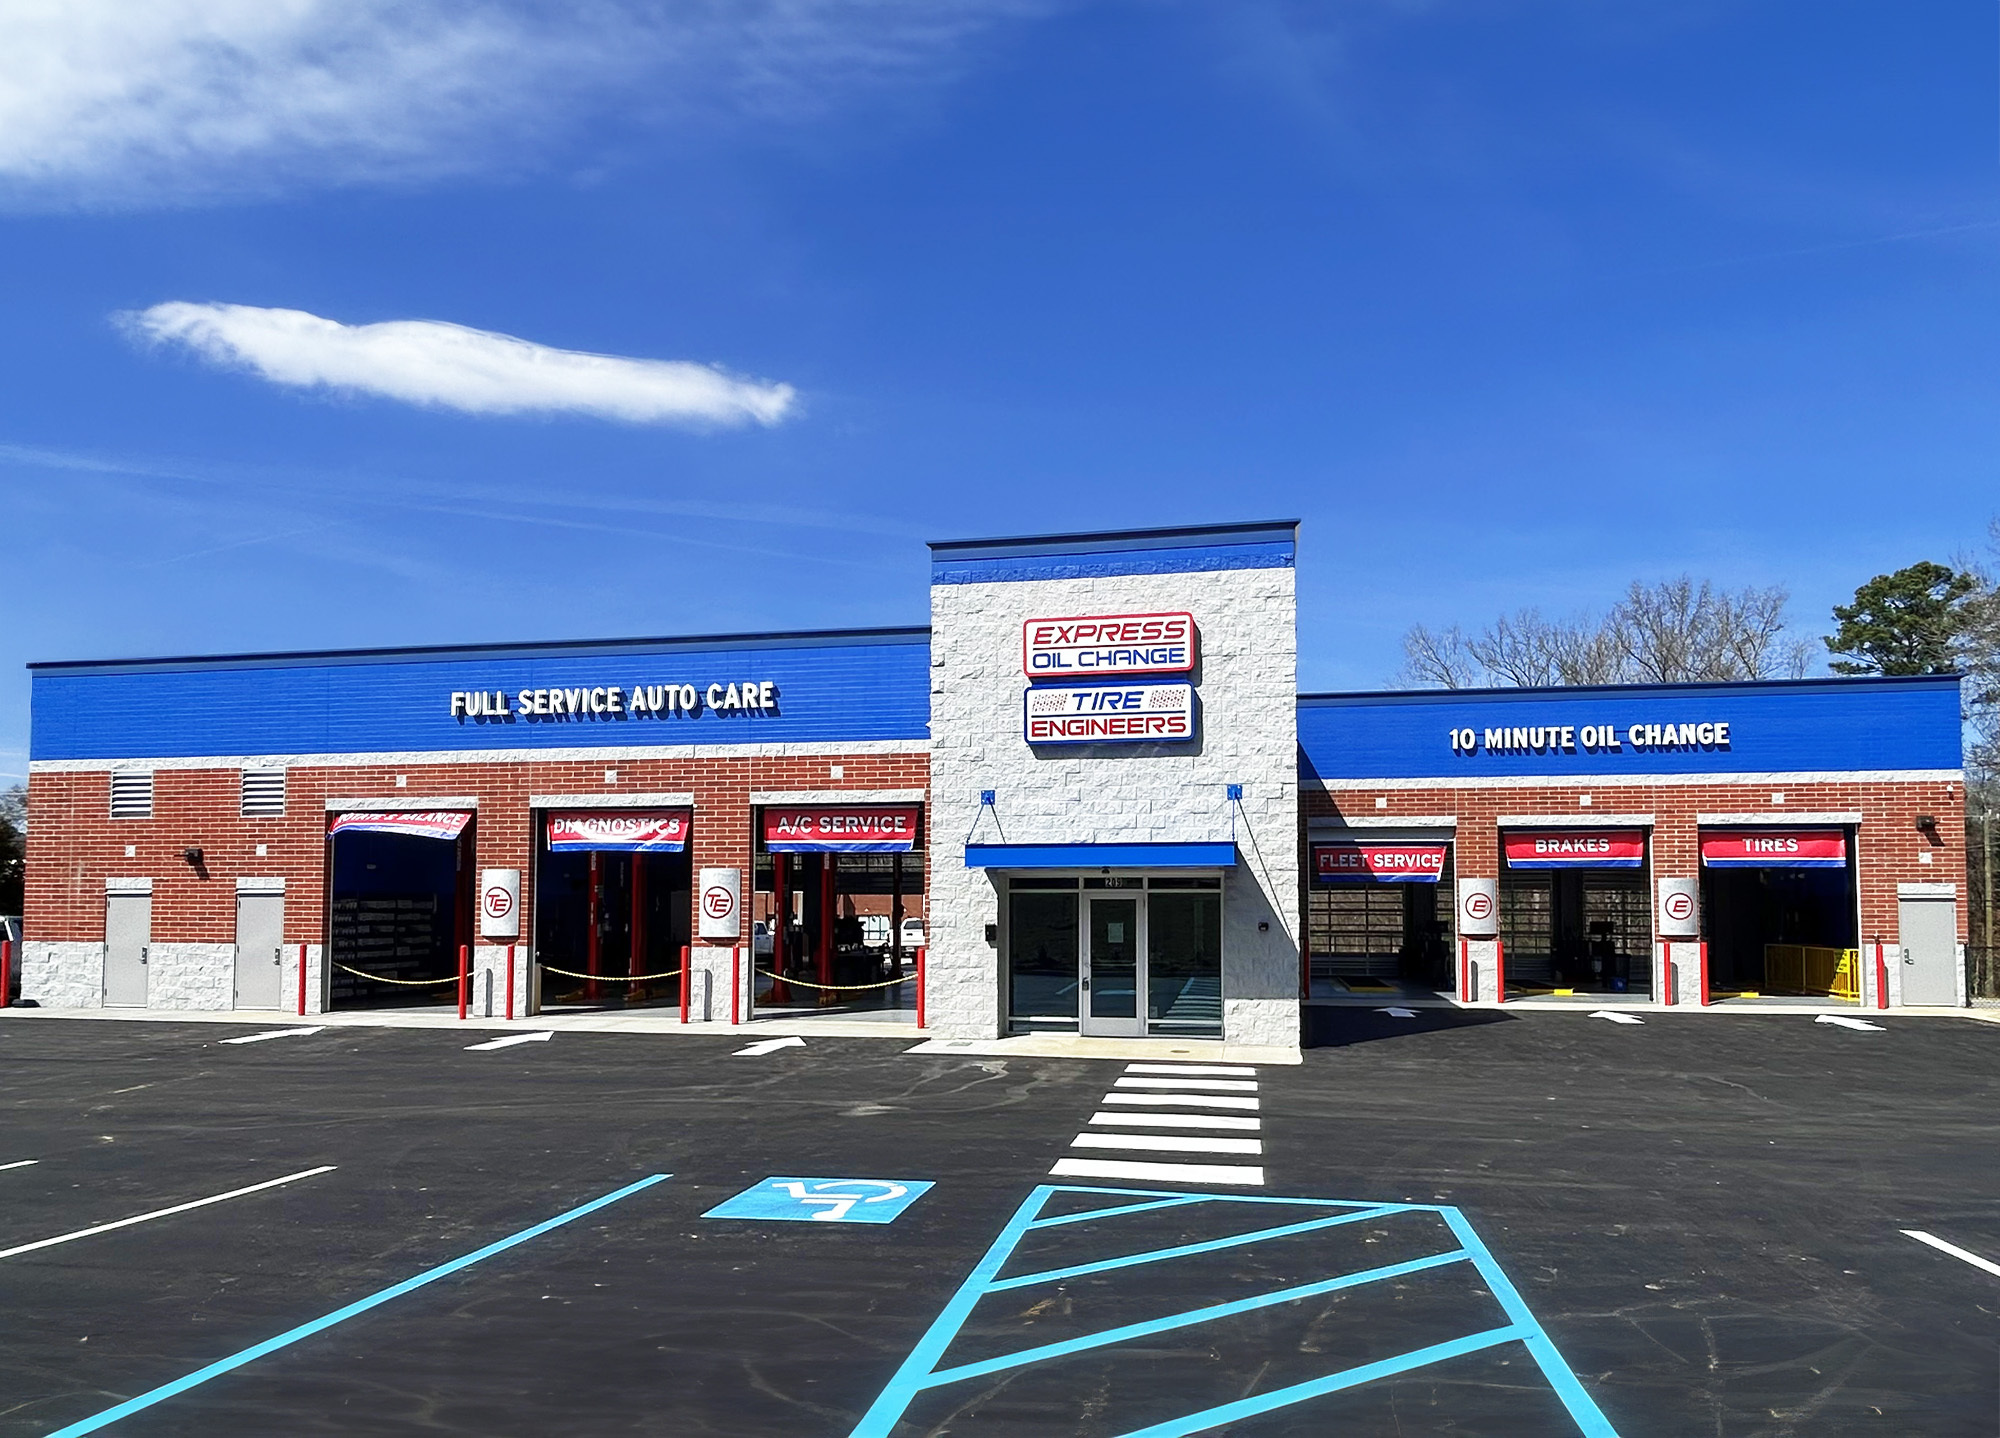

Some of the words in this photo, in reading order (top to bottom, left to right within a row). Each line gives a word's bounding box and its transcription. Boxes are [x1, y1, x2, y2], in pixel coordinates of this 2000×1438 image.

[1033, 620, 1187, 645] EXPRESS
[1032, 652, 1072, 669] OIL
[1078, 647, 1186, 667] CHANGE
[450, 690, 509, 717] FULL
[518, 686, 621, 715] SERVICE
[629, 683, 697, 712] AUTO
[706, 681, 775, 710] CARE
[1071, 690, 1145, 711] TIRE
[1031, 716, 1187, 738] ENGINEERS
[1449, 727, 1476, 750] 10
[1484, 725, 1575, 749] MINUTE
[1580, 724, 1621, 748] OIL
[1628, 722, 1731, 747] CHANGE
[553, 817, 680, 835] DIAGNOSTICS
[776, 815, 812, 836] A/C
[818, 815, 907, 834] SERVICE
[1535, 838, 1610, 853] BRAKES
[1742, 837, 1799, 852] TIRES
[1320, 853, 1369, 868] FLEET
[1373, 853, 1442, 868] SERVICE
